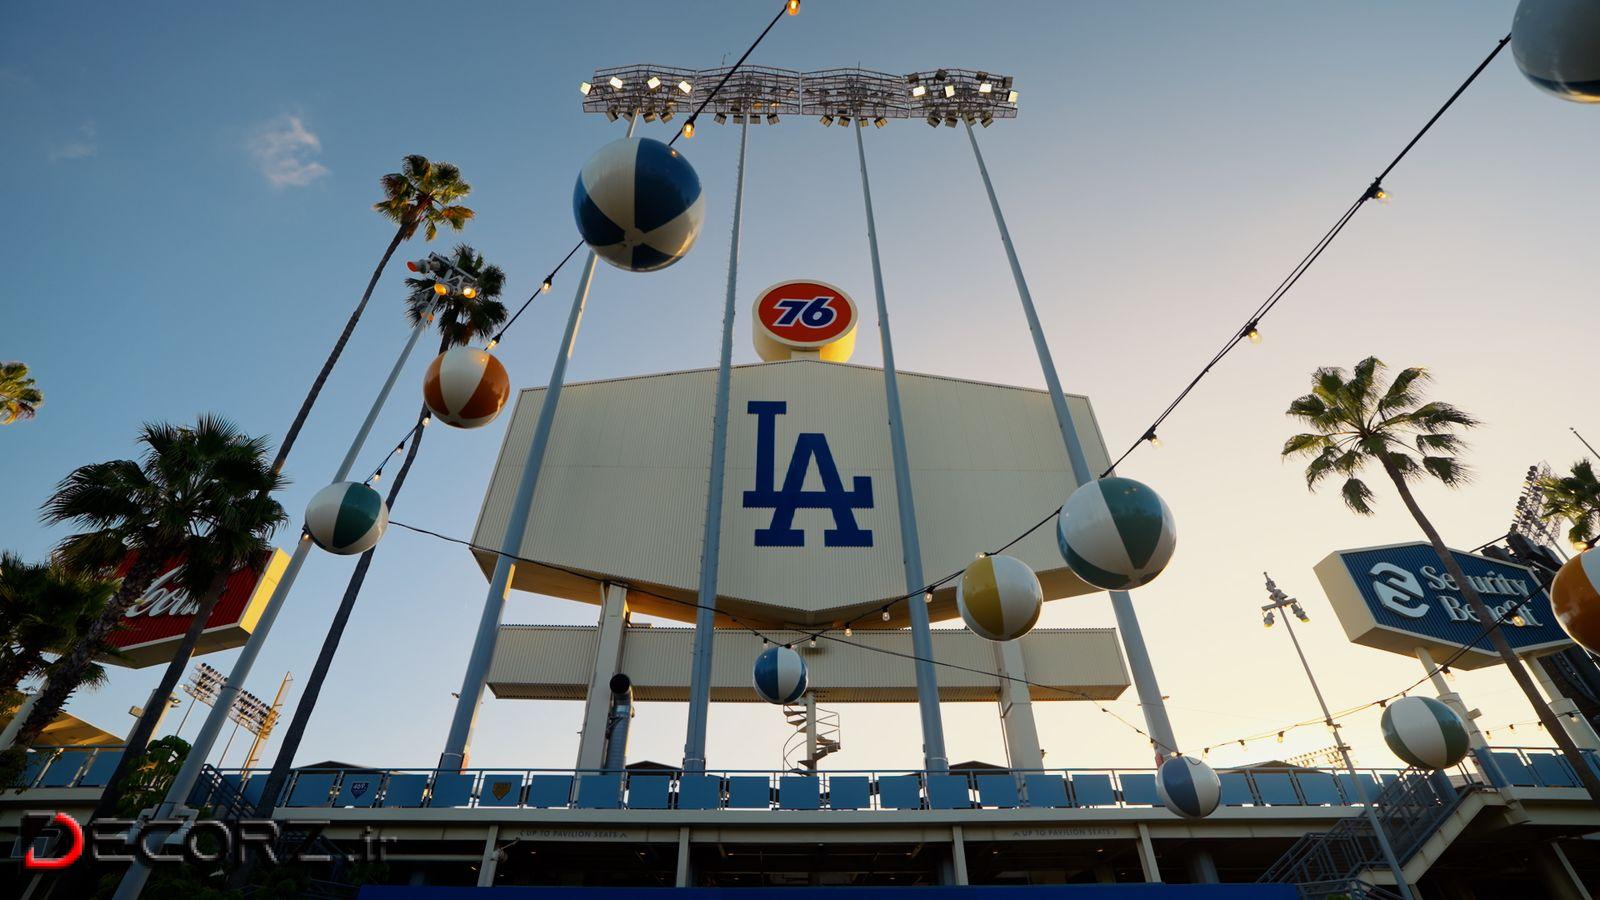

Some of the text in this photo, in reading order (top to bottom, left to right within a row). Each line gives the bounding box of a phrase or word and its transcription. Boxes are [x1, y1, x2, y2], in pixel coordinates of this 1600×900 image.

[773, 296, 837, 329] 76
[743, 401, 874, 547] LA
[1420, 565, 1531, 602] Seurity
